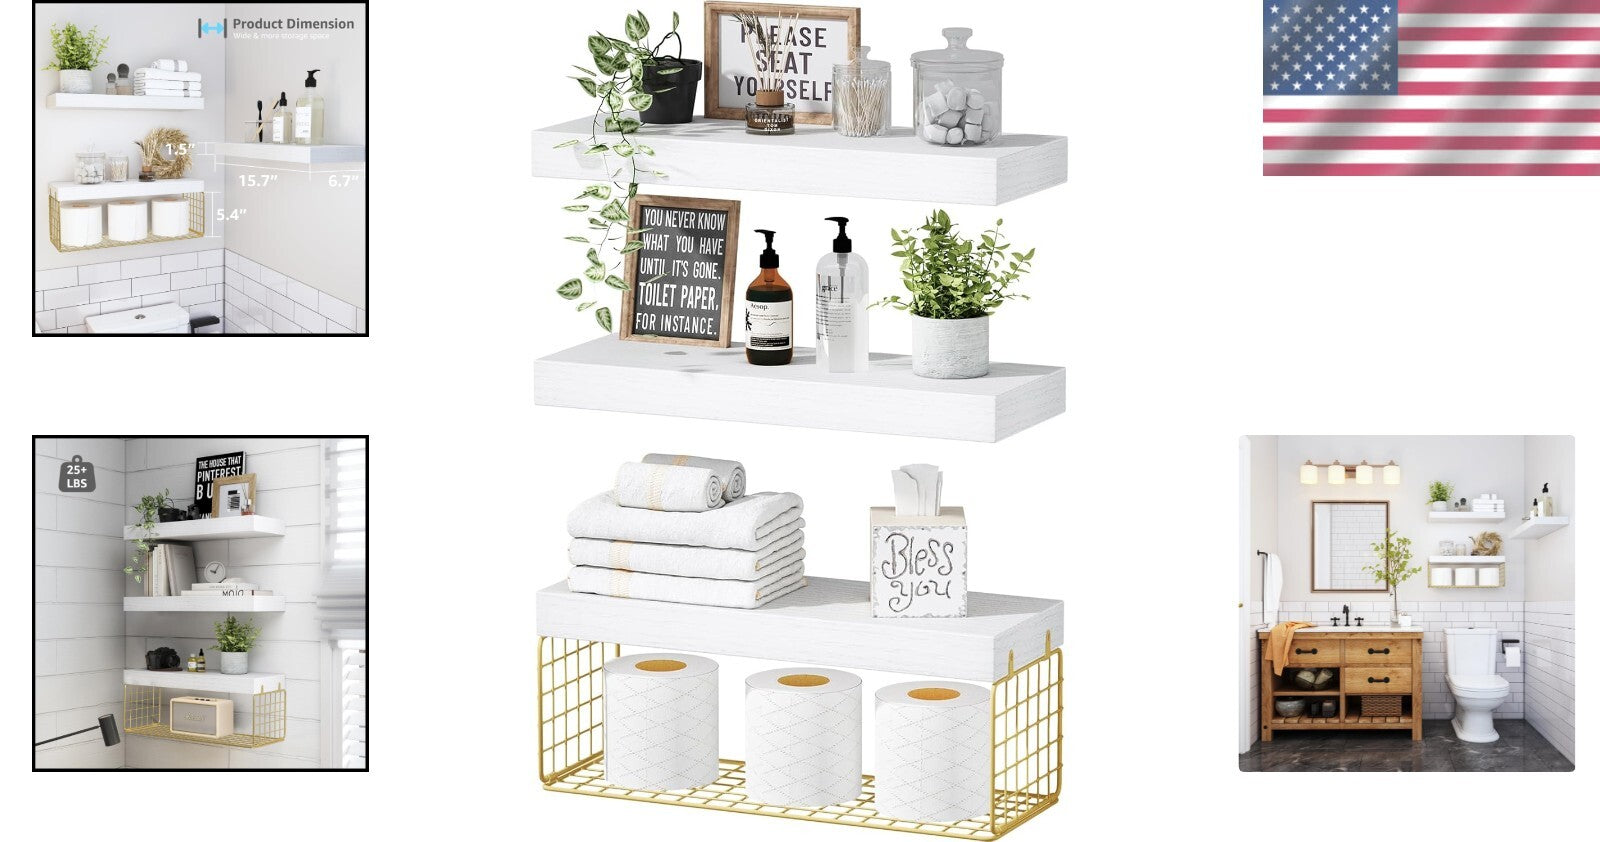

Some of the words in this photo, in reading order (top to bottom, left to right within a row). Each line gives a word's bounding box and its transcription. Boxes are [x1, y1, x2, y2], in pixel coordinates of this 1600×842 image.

[741, 24, 827, 48] PEASE
[755, 49, 813, 75] SEAT
[734, 75, 832, 102] YOSELF
[645, 208, 663, 226] YOU
[664, 210, 696, 229] NEVER
[697, 212, 726, 231] KNOW
[643, 233, 670, 251] WHAT
[676, 235, 694, 253] YOU
[699, 237, 724, 256] HAVE
[640, 257, 666, 275] UNTIL
[671, 260, 689, 278] IT'S
[692, 262, 721, 280] GONE.
[639, 282, 677, 307] TOILET
[680, 285, 719, 311] PAPER,
[635, 312, 656, 331] FOR
[660, 314, 717, 336] INSTANCE.
[197, 466, 242, 483] PINTEREST
[198, 460, 209, 470] THE
[209, 458, 227, 468] HOUSE
[228, 455, 242, 466] THAT
[881, 532, 954, 580] Bless
